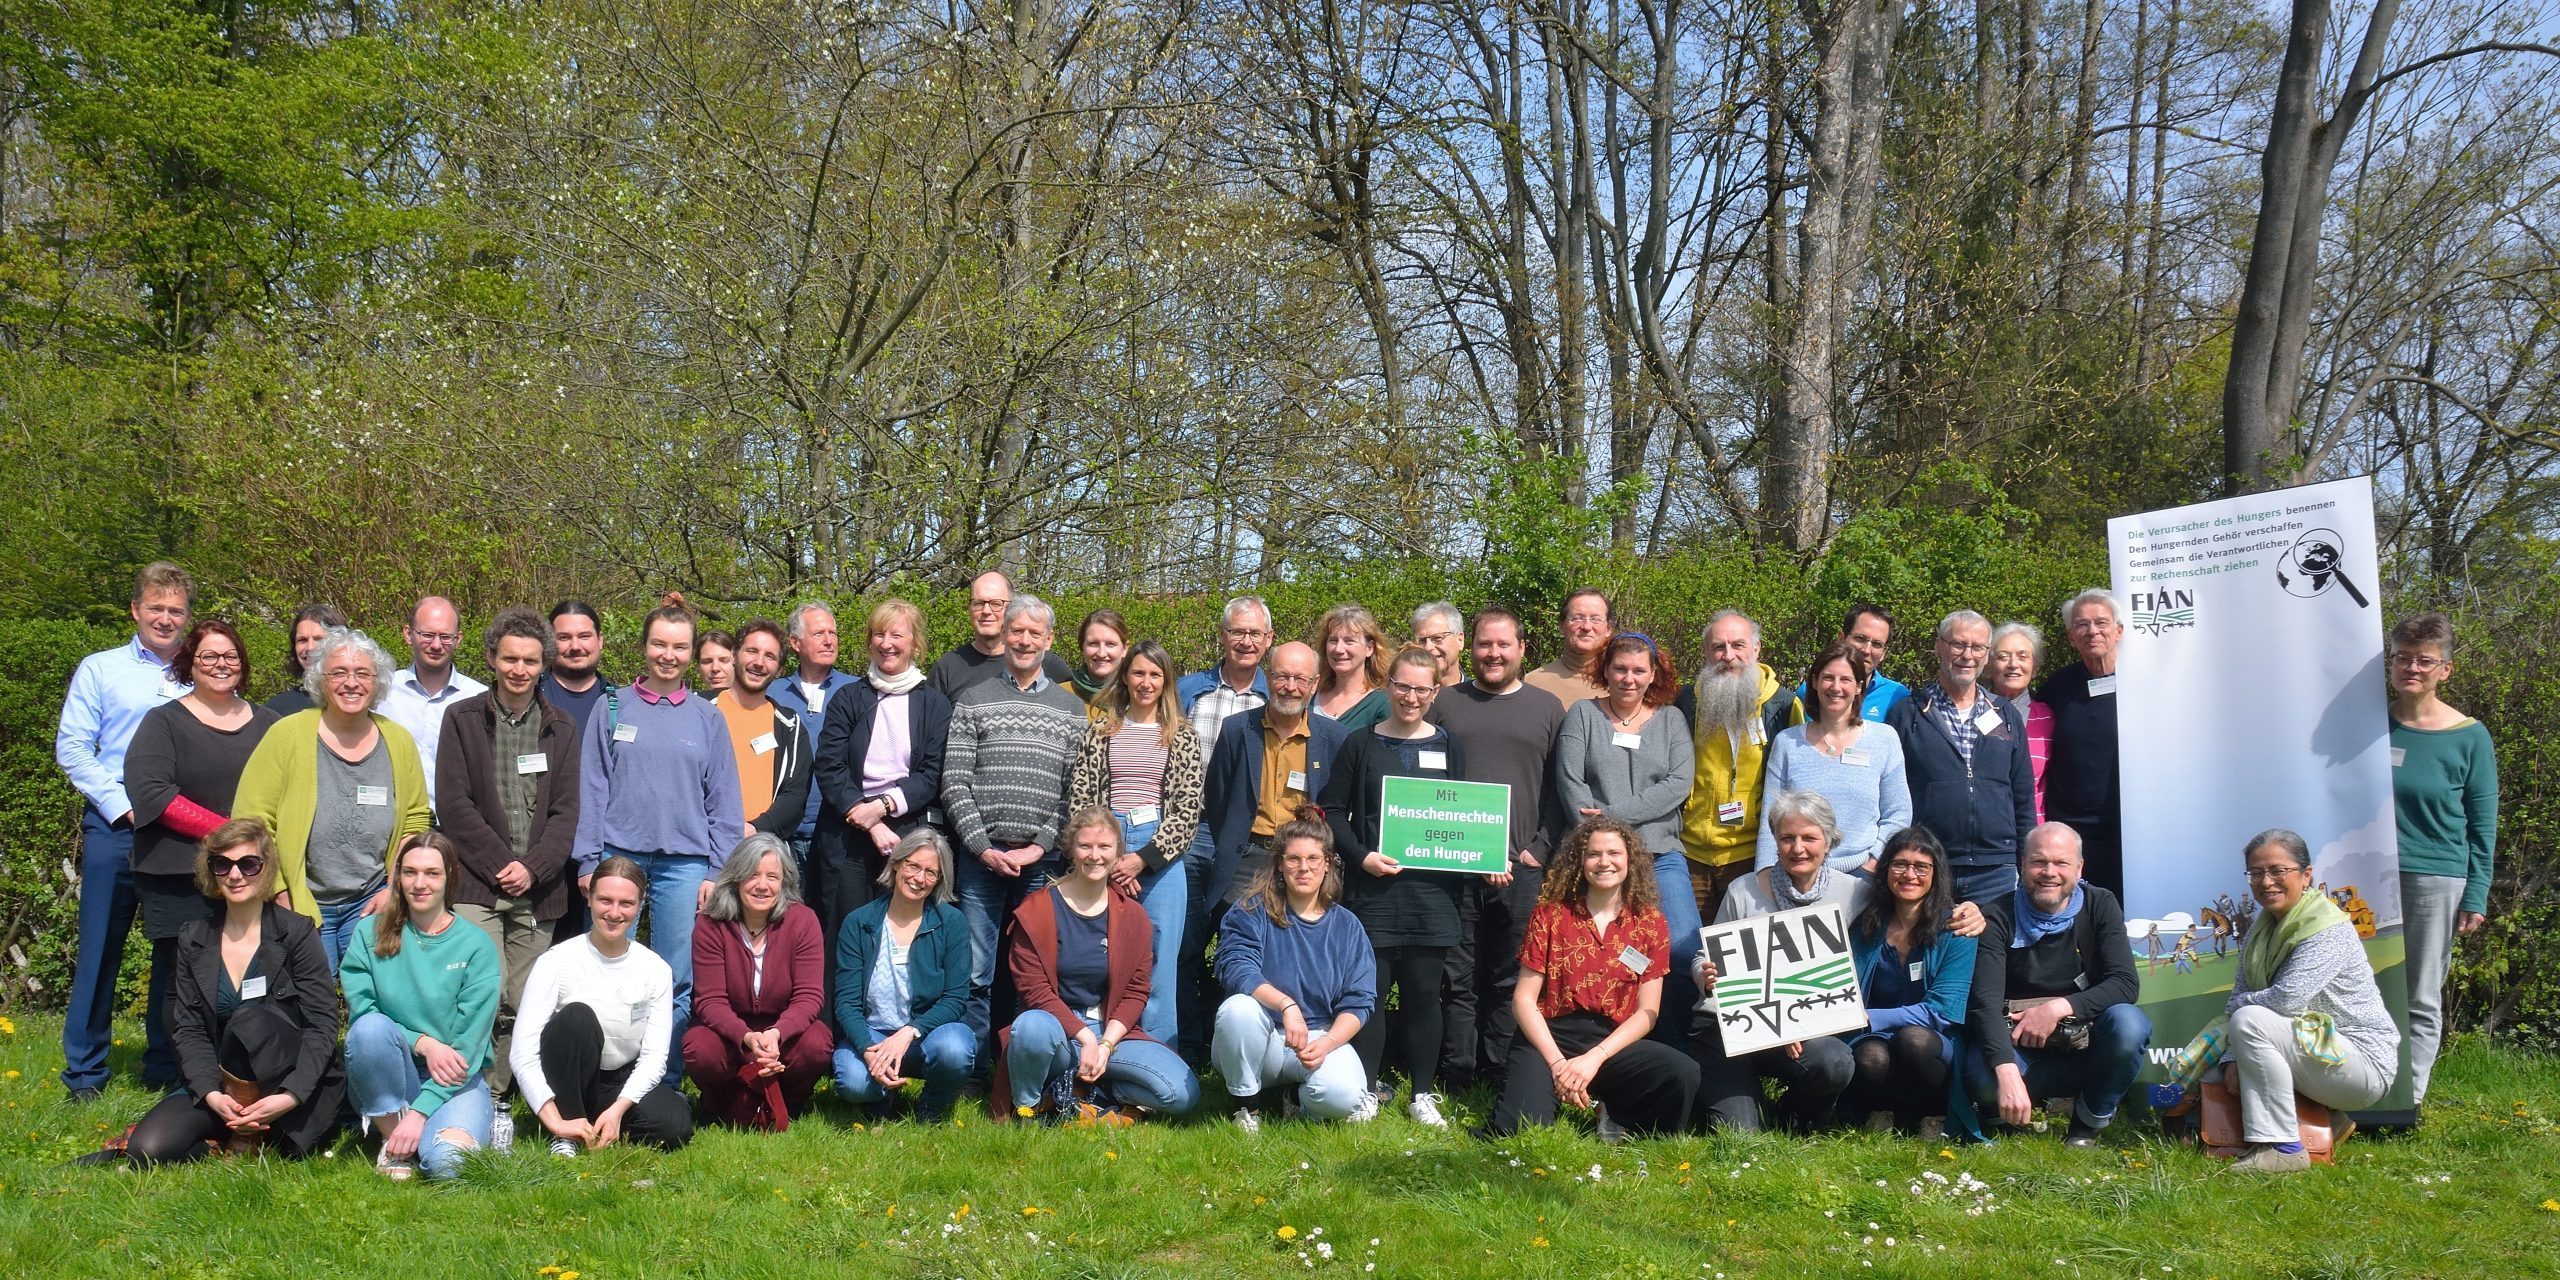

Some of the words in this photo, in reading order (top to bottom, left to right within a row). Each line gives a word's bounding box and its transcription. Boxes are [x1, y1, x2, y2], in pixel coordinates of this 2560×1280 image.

[2128, 531, 2144, 539] Die
[2148, 521, 2210, 536] Verursacher
[2214, 517, 2232, 526] des
[2237, 509, 2282, 523] Hungers
[2286, 501, 2336, 515] benennen
[2129, 546, 2146, 554] Den
[2151, 537, 2208, 551] Hungernden
[2212, 531, 2241, 542] Gehör
[2245, 522, 2303, 536] verschaffen
[2130, 556, 2184, 567] Gemeinsam
[2189, 553, 2203, 561] die
[2206, 540, 2289, 558] Verantwortlichen
[2151, 564, 2220, 581] Rechenschaft
[2224, 559, 2258, 572] ziehen
[2131, 586, 2194, 611] FIAN
[1436, 789, 1458, 801] Mit
[1388, 805, 1504, 824] Menschenrechten
[1425, 829, 1465, 842] gegen
[1406, 844, 1430, 858] den
[1434, 846, 1483, 863] Hunger
[1705, 909, 1848, 978] FIAN
